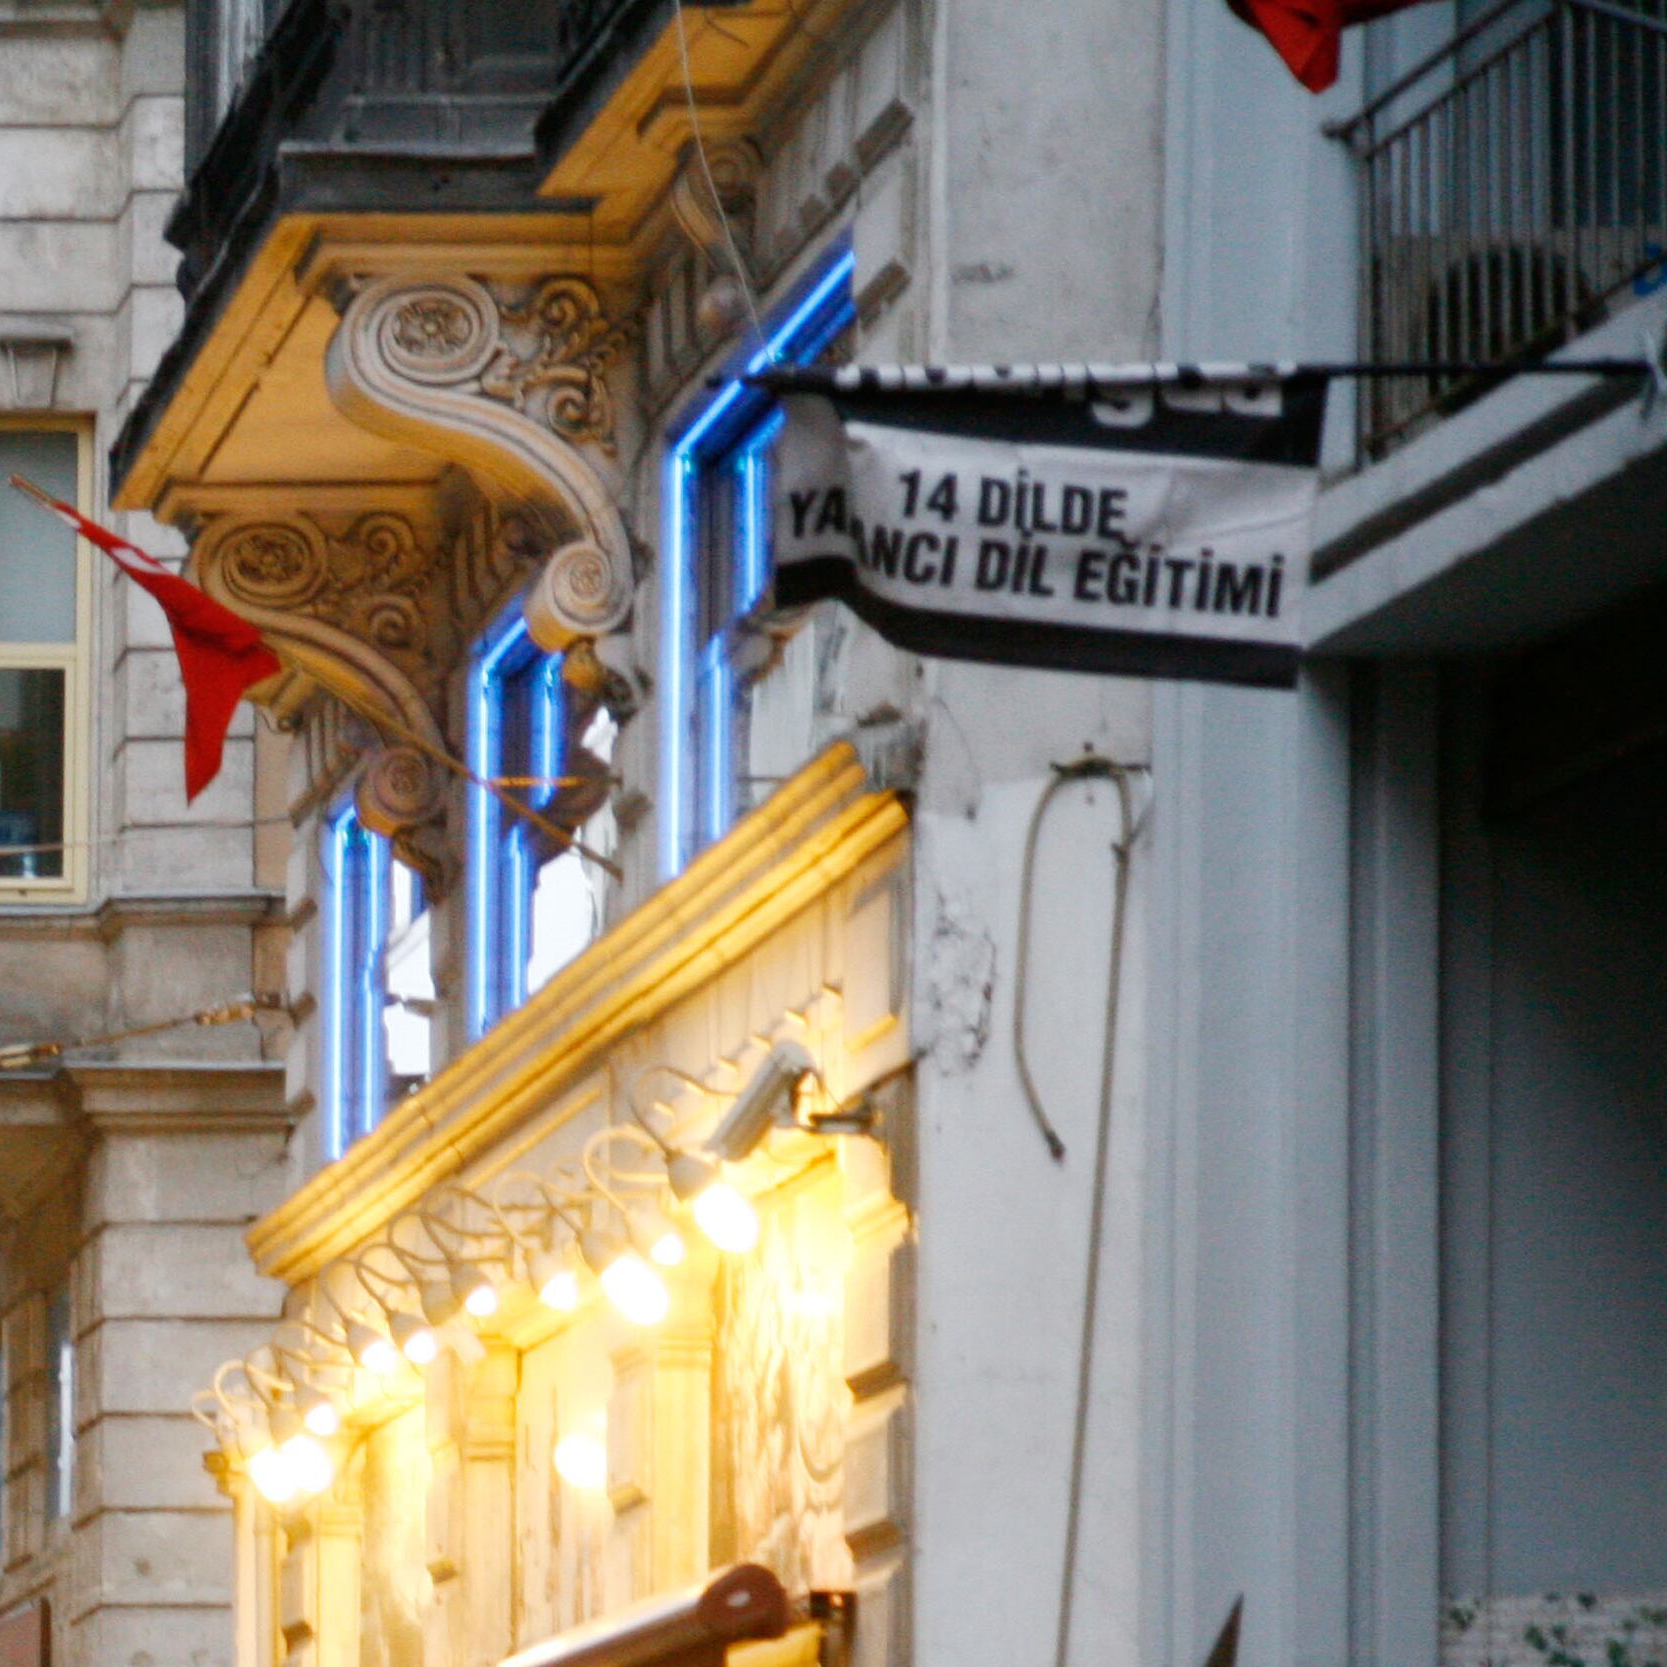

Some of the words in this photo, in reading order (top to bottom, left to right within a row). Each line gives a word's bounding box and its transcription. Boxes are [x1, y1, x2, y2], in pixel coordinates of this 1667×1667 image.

[898, 468, 959, 523] 14
[976, 467, 1130, 541] DİLDE
[974, 530, 1055, 598] DİL
[1072, 536, 1286, 619] EĞİTİMİ
